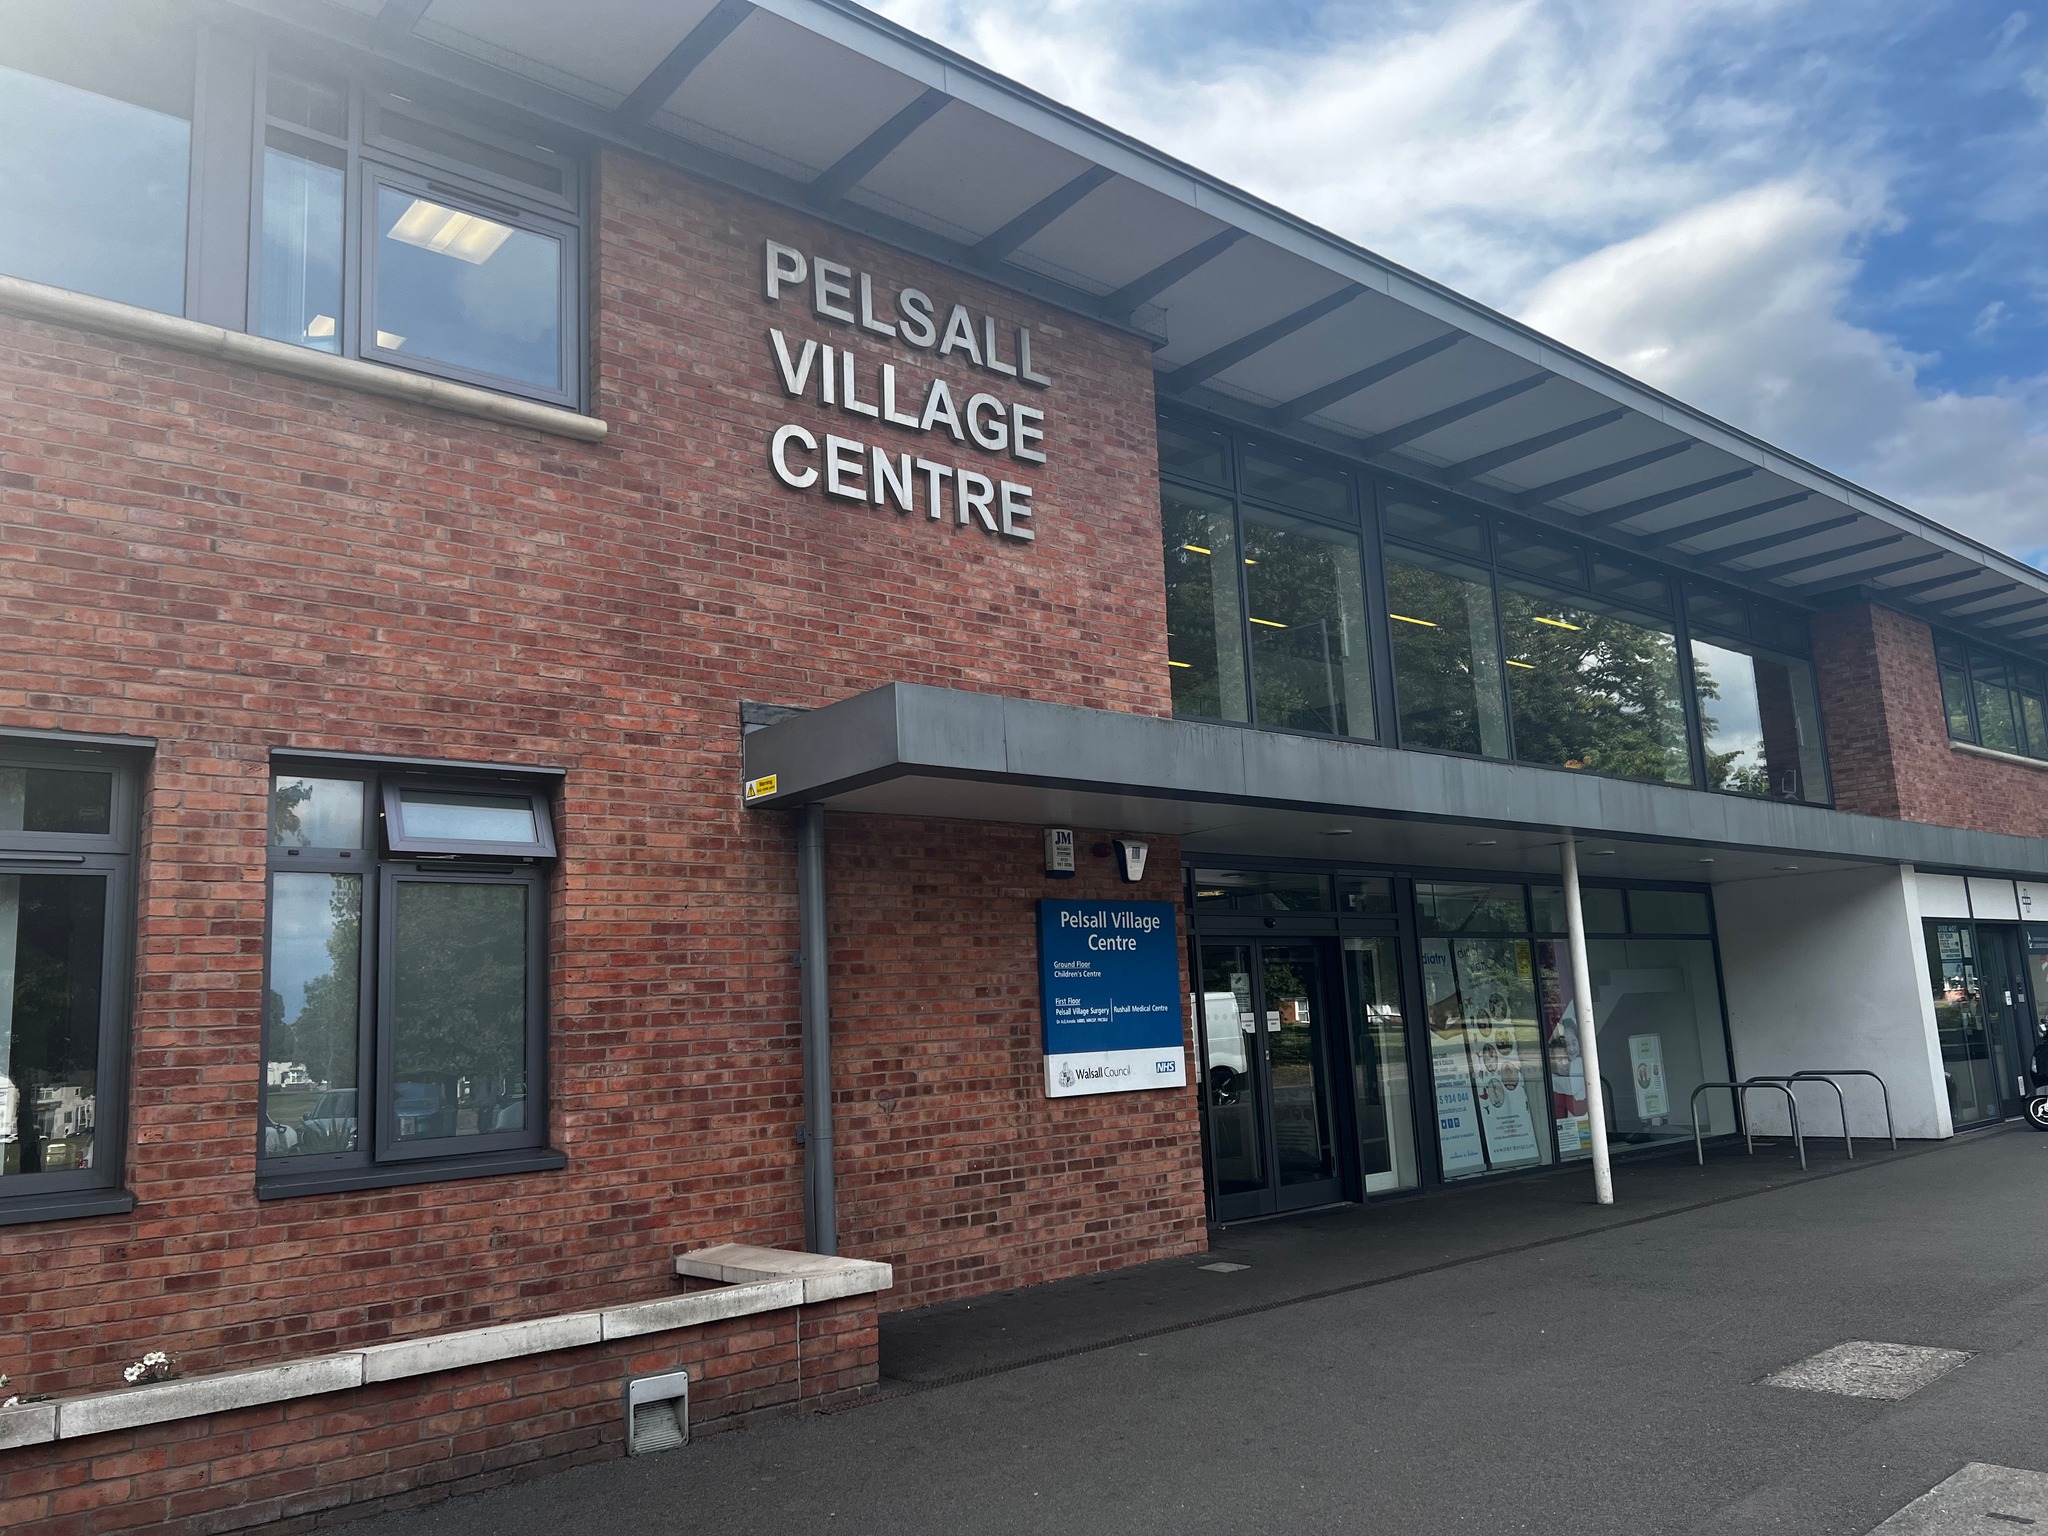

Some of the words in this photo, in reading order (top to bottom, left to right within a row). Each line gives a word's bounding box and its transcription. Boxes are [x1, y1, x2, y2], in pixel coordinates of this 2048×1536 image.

[765, 238, 1051, 388] PELSALL
[767, 327, 1047, 464] VILLAGE
[769, 423, 1035, 541] CENTRE
[1055, 831, 1072, 845] JM
[1060, 910, 1107, 928] Pelsall
[1111, 911, 1160, 933] Village
[1088, 934, 1137, 951] Centre
[1053, 961, 1076, 969] Ground
[1076, 961, 1091, 969] Floor
[1055, 1007, 1072, 1015] Pelsall
[1072, 1007, 1089, 1016] Village
[1090, 1007, 1110, 1016] Surgery
[1113, 1005, 1131, 1013] Rushall
[1075, 1066, 1103, 1079] Walsall
[1103, 1065, 1131, 1077] Council
[1157, 1062, 1175, 1073] NHS
[1444, 1094, 1456, 1104] 934
[1457, 1092, 1469, 1102] 044
